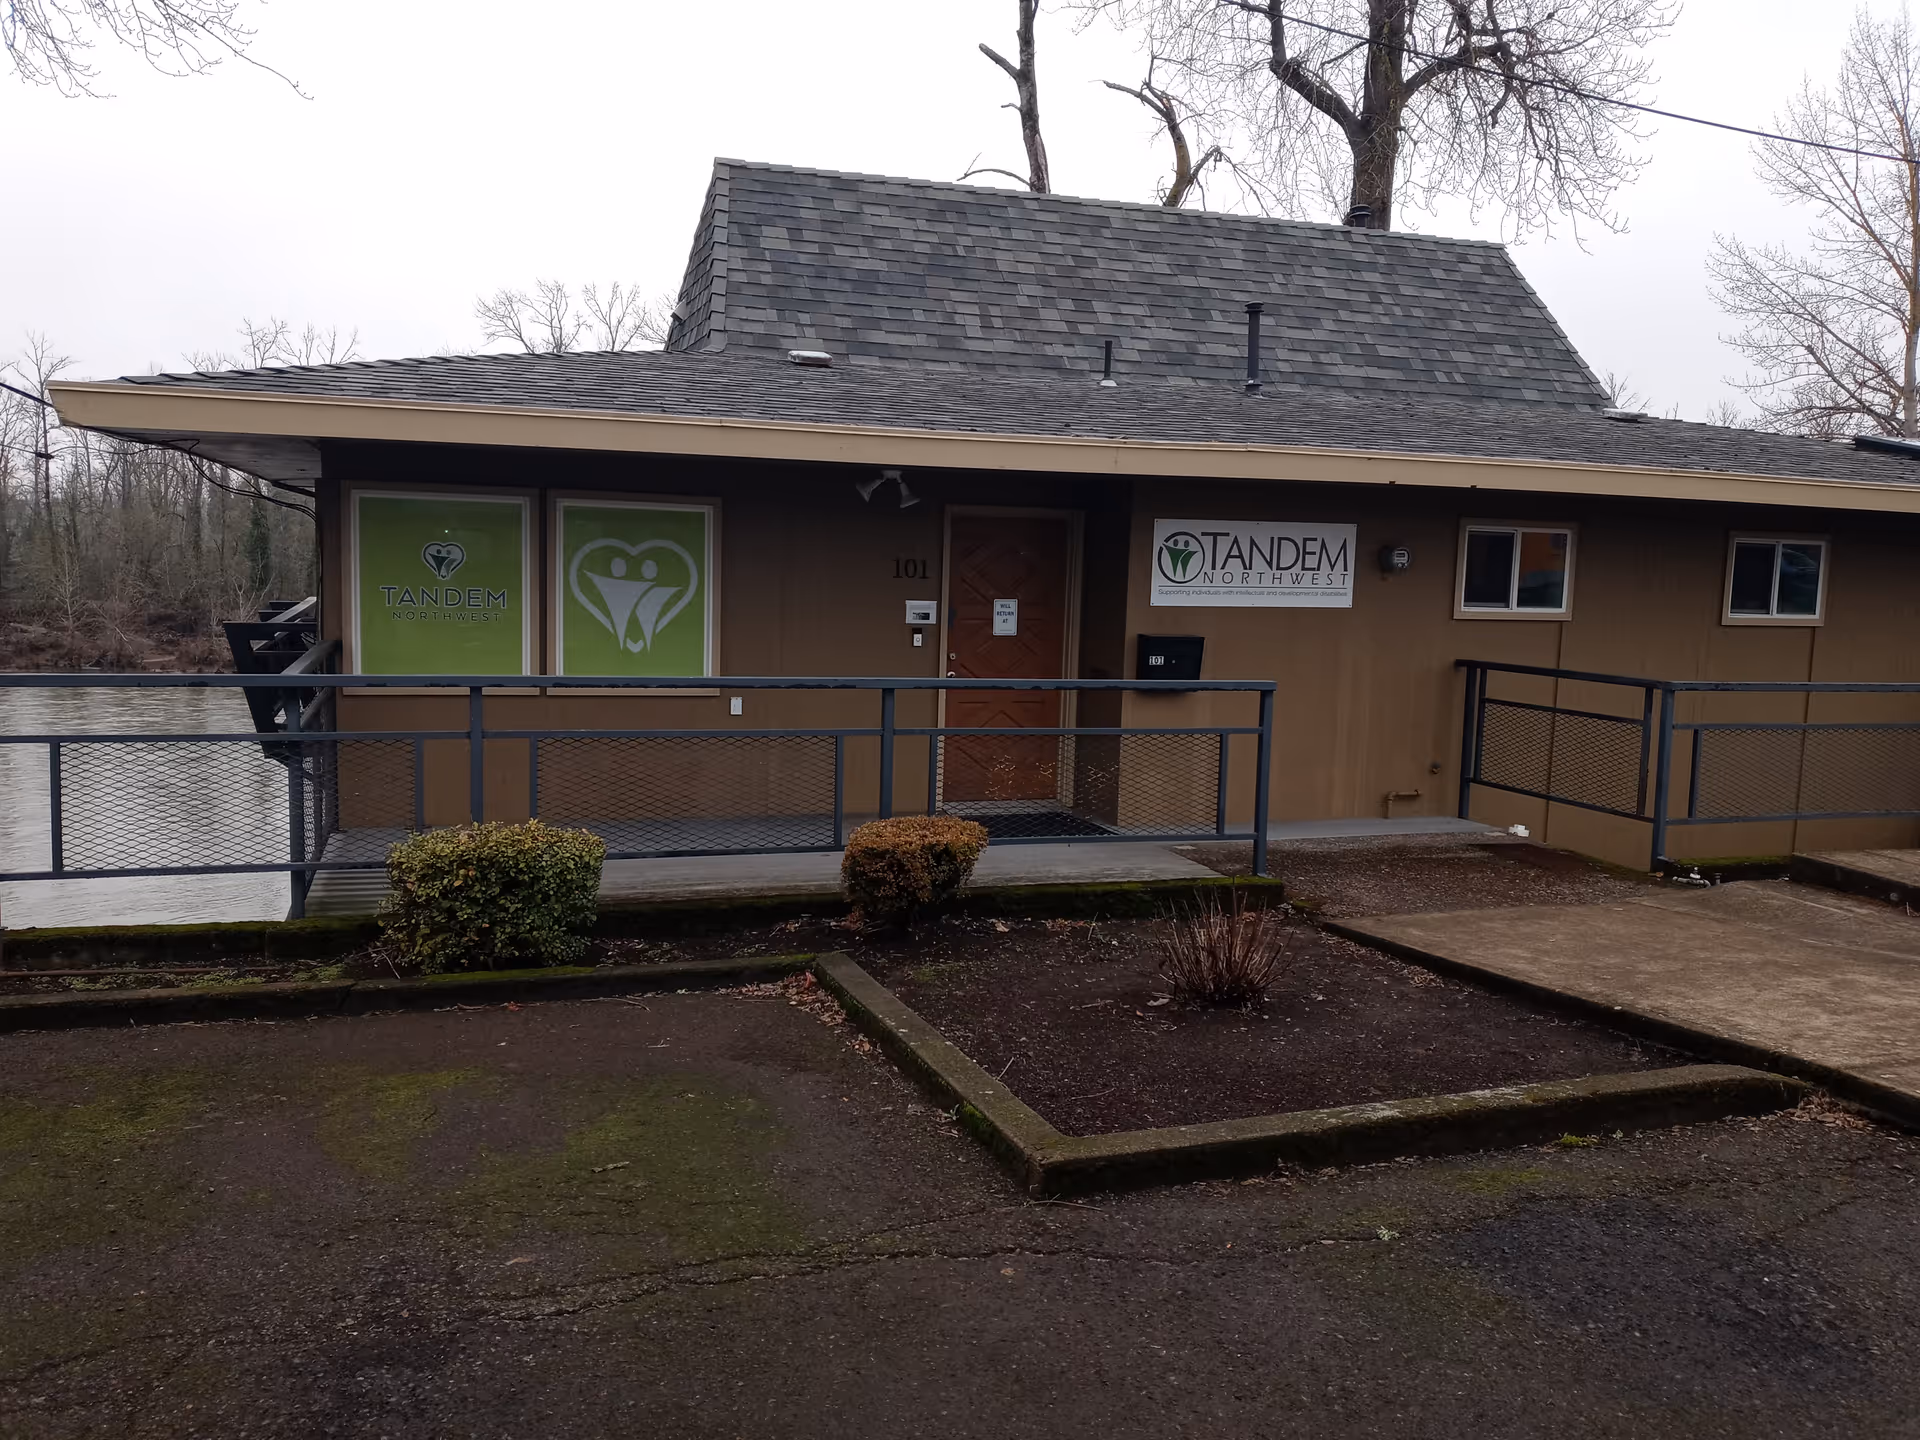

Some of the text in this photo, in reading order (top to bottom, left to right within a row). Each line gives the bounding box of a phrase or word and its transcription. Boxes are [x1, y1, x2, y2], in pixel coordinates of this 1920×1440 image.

[1201, 532, 1348, 572] TANDEM
[892, 558, 930, 579] 101
[1203, 572, 1348, 586] NORTHWEST
[380, 585, 507, 609] TANDEM
[1158, 588, 1190, 596] Supporting
[392, 611, 500, 622] NORTHWEST
[1149, 655, 1164, 665] 101
